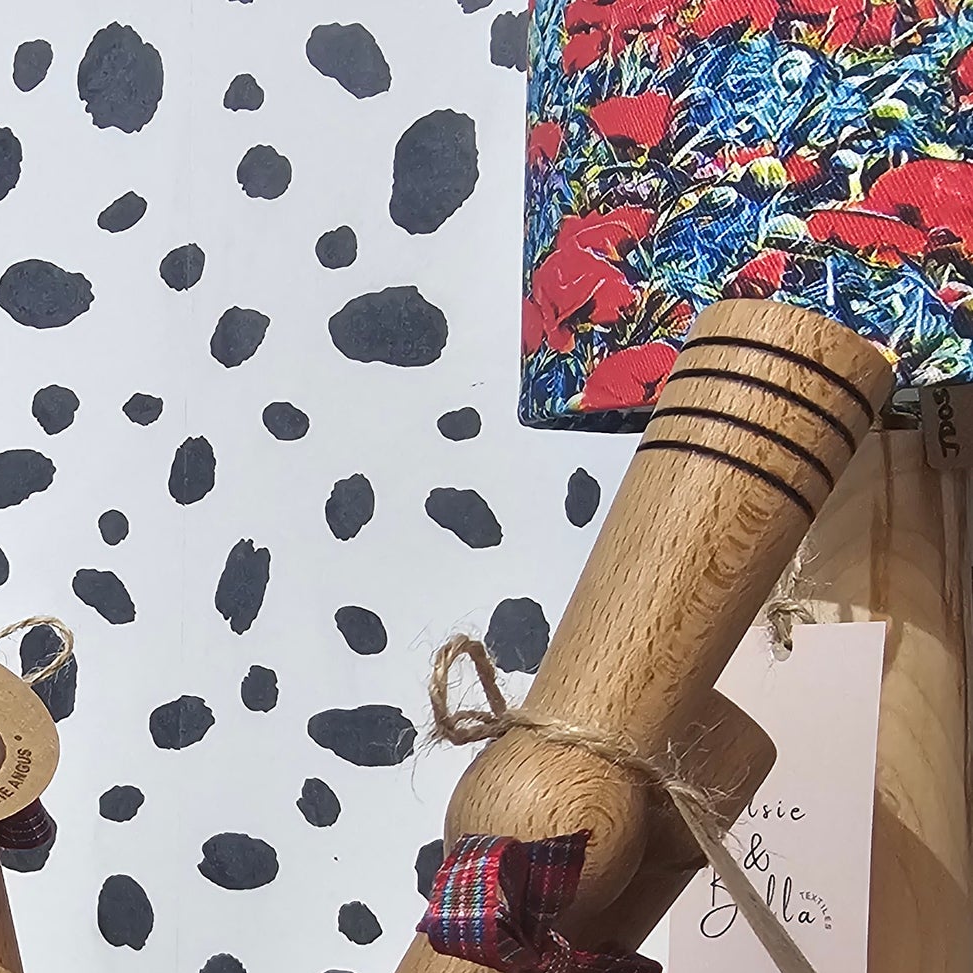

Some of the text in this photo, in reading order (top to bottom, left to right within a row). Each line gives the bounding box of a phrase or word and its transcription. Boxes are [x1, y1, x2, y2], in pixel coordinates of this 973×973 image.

[10, 748, 33, 789] ANGUS
[747, 800, 807, 820] lsie
[743, 833, 770, 872] &
[700, 867, 816, 938] Blla
[799, 891, 833, 930] TEXTILES
